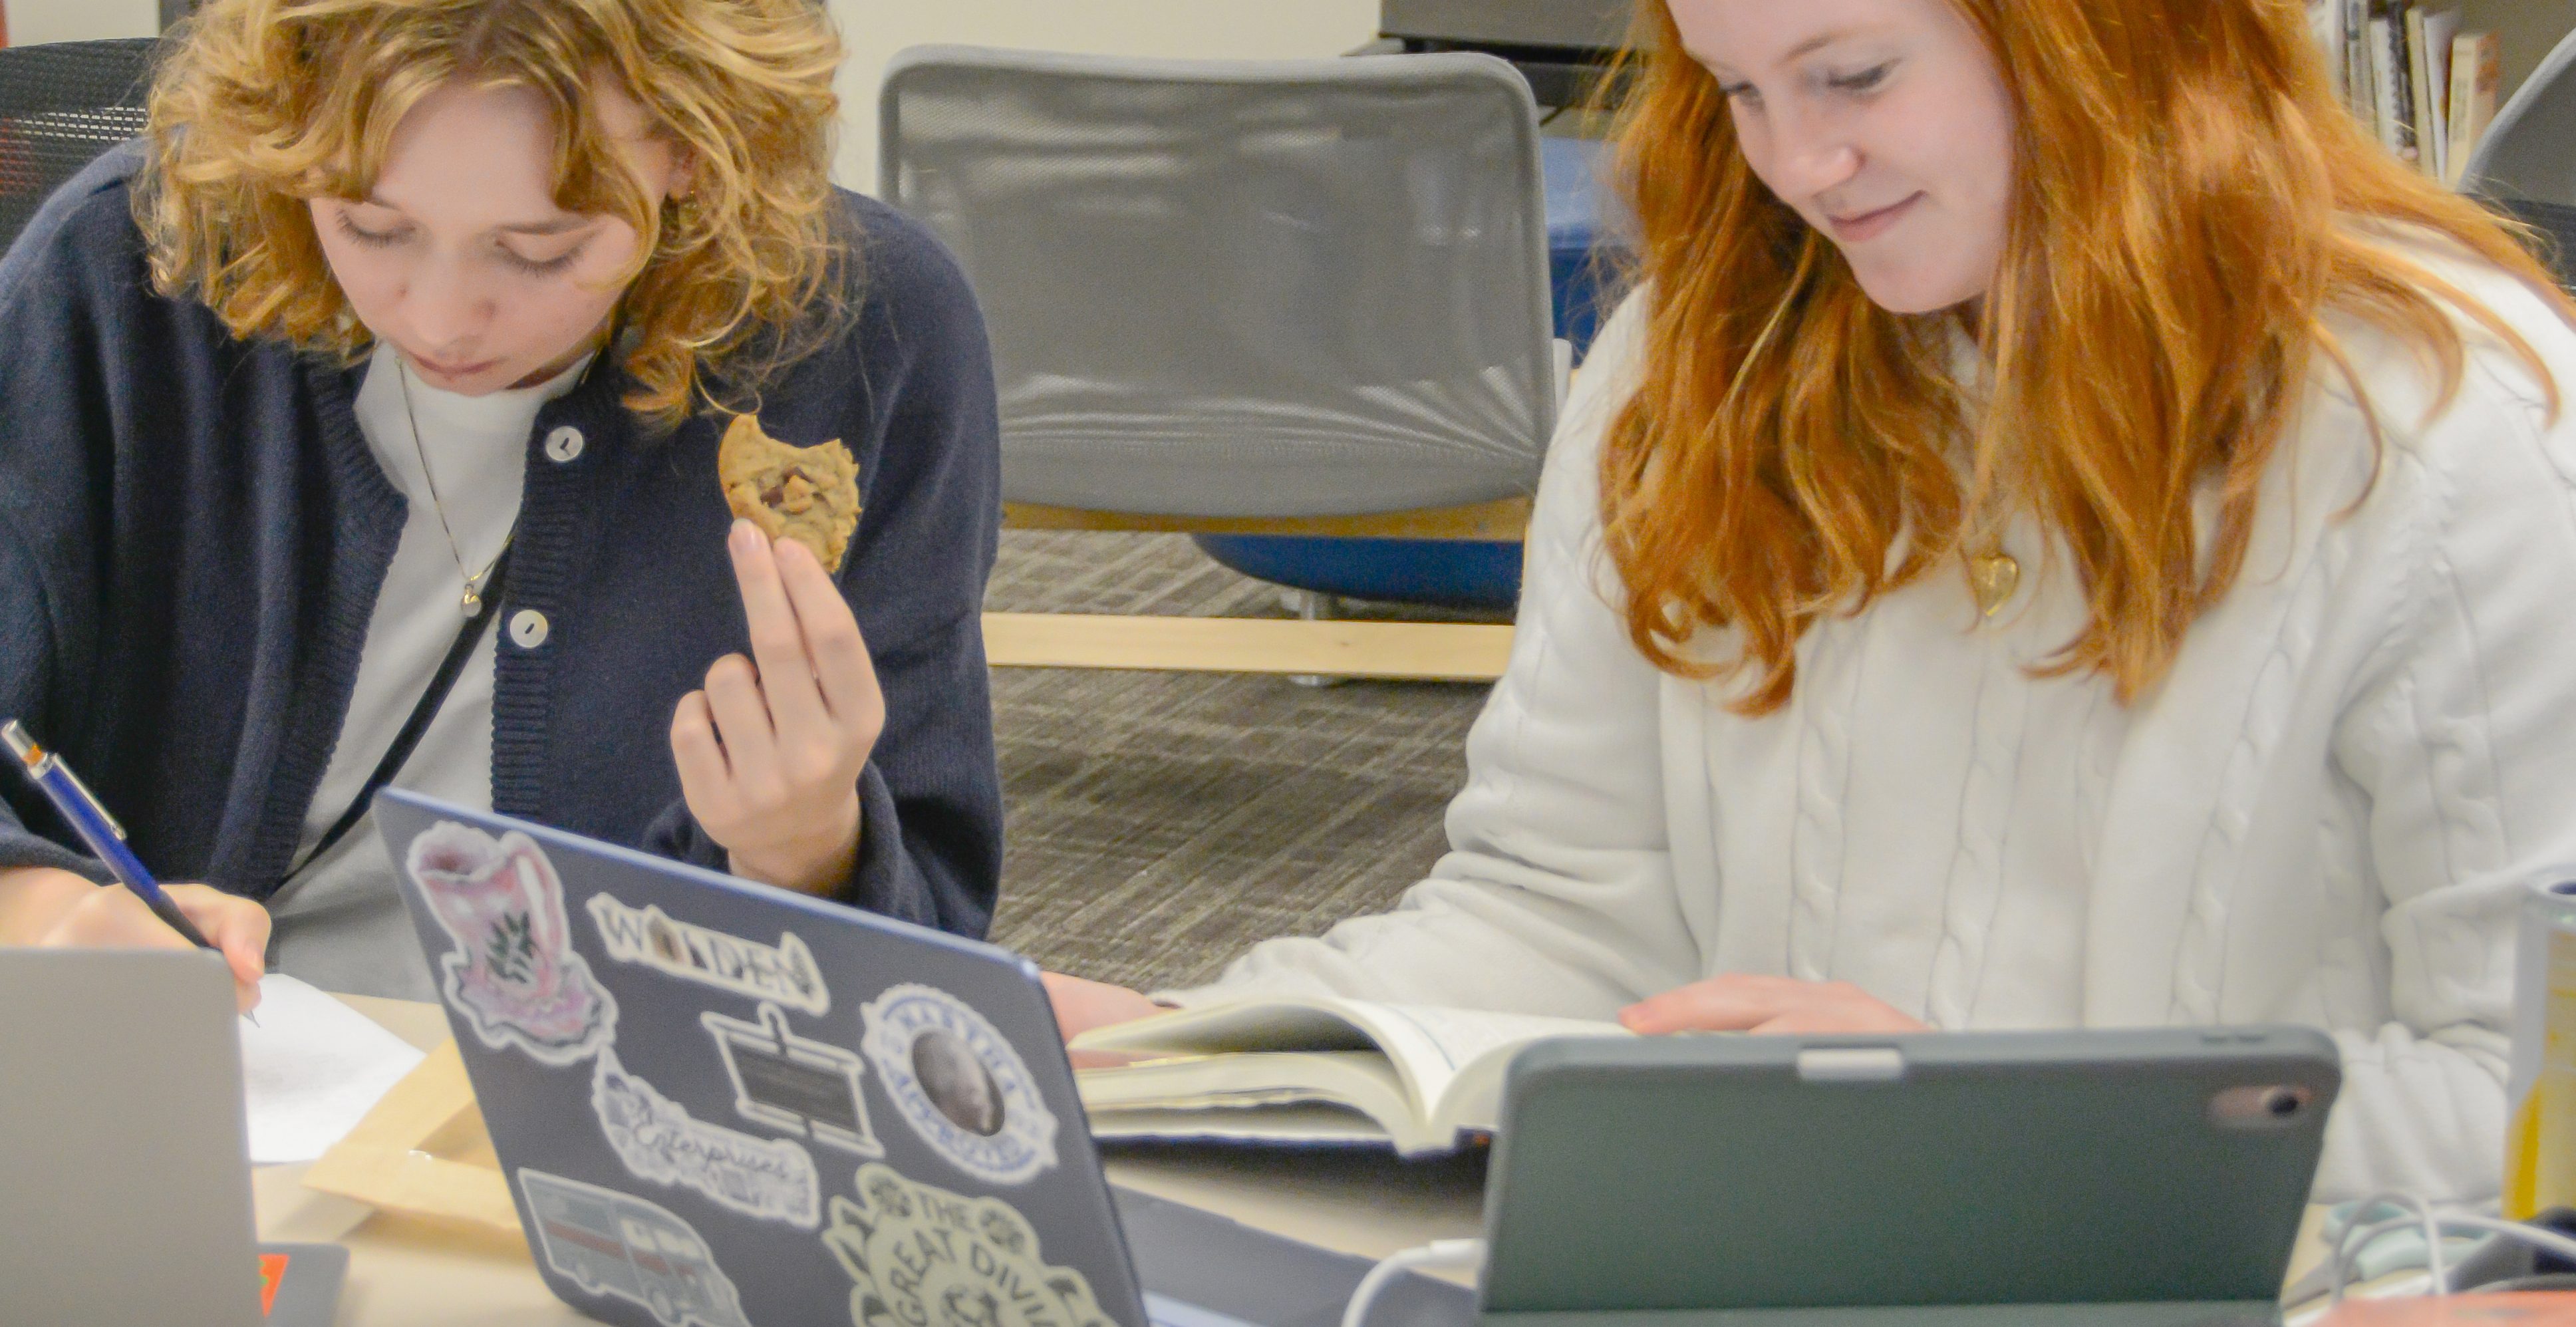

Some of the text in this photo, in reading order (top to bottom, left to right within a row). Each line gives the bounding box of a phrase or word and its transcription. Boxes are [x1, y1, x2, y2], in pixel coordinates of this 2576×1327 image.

[918, 1192, 976, 1233] THE
[890, 1228, 1058, 1327] GREAT DIVI
